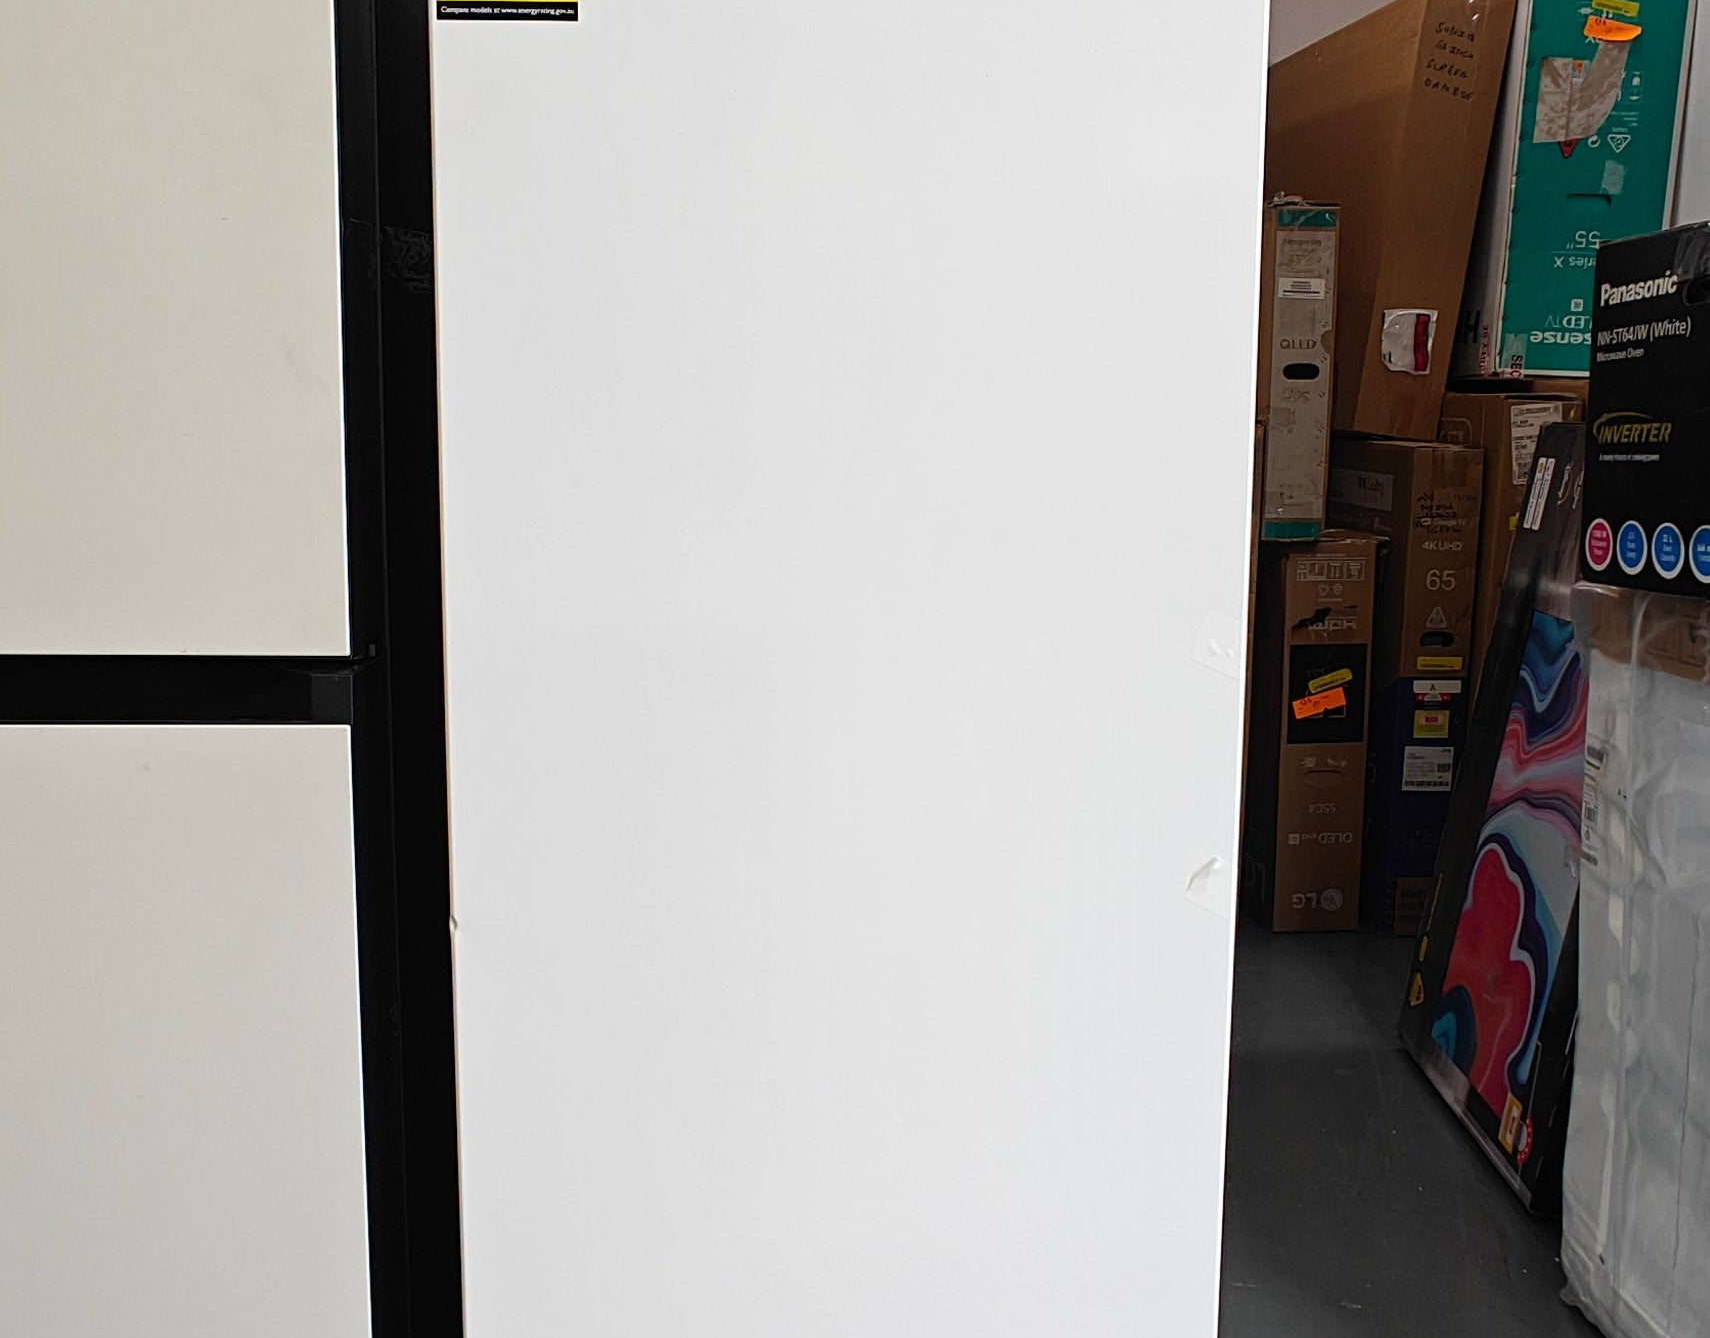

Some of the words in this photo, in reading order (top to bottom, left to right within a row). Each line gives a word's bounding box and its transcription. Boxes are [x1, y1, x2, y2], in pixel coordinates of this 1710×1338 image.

[440, 6, 469, 14] Compare
[470, 6, 492, 14] models
[1553, 256, 1565, 268] X
[1600, 269, 1679, 307] Panasonic
[1544, 315, 1560, 329] TV
[1650, 315, 1692, 342] (White)
[1529, 331, 1593, 345] sense
[1627, 347, 1645, 360] Oven
[1598, 422, 1673, 444] INVERTER
[1426, 568, 1456, 591] 65
[1318, 831, 1353, 844] OLED
[1291, 892, 1317, 909] LG
